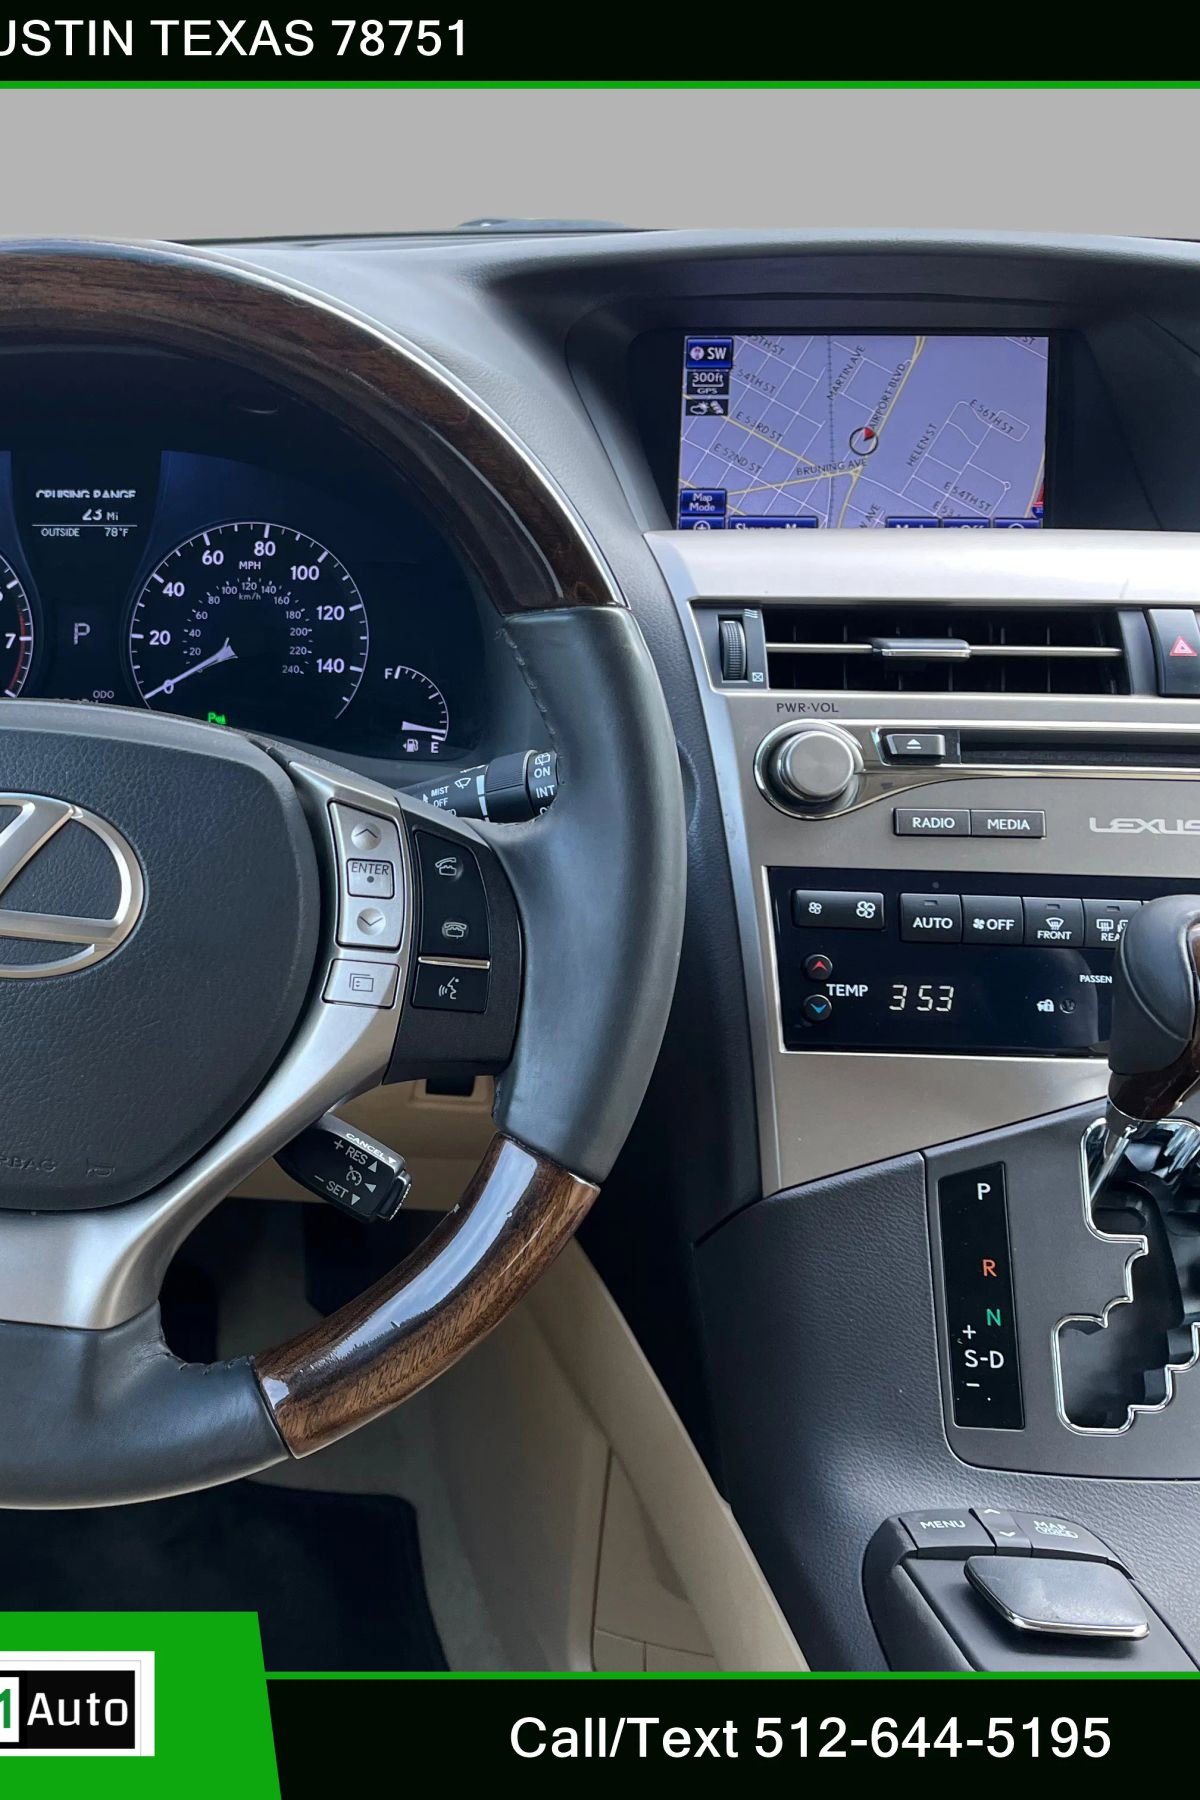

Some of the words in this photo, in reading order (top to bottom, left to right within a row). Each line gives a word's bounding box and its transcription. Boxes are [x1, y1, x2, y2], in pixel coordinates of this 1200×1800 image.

[707, 347, 727, 360] SW
[692, 372, 723, 382] 300ft
[827, 364, 854, 400] MARTIN
[850, 345, 865, 364] AVE
[870, 390, 893, 430] AIRPORT
[888, 363, 906, 389] BLVD
[969, 399, 977, 407] E
[977, 404, 1004, 426] 56TH
[1003, 422, 1014, 433] ST
[735, 411, 743, 420] E
[770, 432, 783, 442] ST
[906, 436, 931, 467] HELEN
[928, 424, 937, 437] ST
[713, 443, 721, 451] E
[749, 463, 762, 474] ST
[796, 461, 844, 477] BRUNING
[848, 458, 867, 469] AVE
[692, 493, 713, 503] Map
[689, 503, 716, 512] Mode
[979, 500, 992, 512] ST
[106, 511, 119, 521] Mi
[41, 528, 80, 537] OUTSIDE
[254, 541, 276, 557] 80
[202, 550, 224, 566] 60
[238, 560, 262, 571] MPH
[290, 565, 320, 581] 100
[163, 582, 185, 597] 40
[221, 586, 238, 595] 100
[241, 582, 257, 591] 120
[261, 586, 277, 594] 140
[208, 596, 220, 605] 80
[238, 592, 261, 601] km/h
[273, 596, 290, 605] 160
[195, 611, 208, 620] 60
[285, 610, 301, 619] 180
[316, 605, 345, 620] 120
[74, 623, 90, 645] P
[149, 630, 171, 645] 20
[188, 629, 201, 637] 40
[289, 627, 308, 636] 200
[5, 634, 16, 648] 7
[189, 647, 201, 656] 20
[289, 646, 307, 655] 220
[282, 665, 300, 674] 240
[316, 658, 345, 674] 140
[385, 668, 393, 679] F
[92, 690, 115, 699] ODO
[431, 741, 439, 753] E
[534, 766, 550, 778] ON
[431, 785, 449, 797] MIST
[535, 785, 555, 799] INT
[912, 816, 955, 829] RADIO
[987, 818, 1030, 831] MEDIA
[351, 862, 389, 876] ENTER
[913, 917, 953, 930] AUTO
[986, 918, 1015, 931] OFF
[1037, 930, 1072, 941] FRONT
[1101, 932, 1120, 942] REA
[1079, 974, 1113, 984] PASSEN
[826, 983, 869, 997] TEMP
[345, 1132, 386, 1160] CANCEL
[977, 1182, 991, 1201] P
[983, 1259, 997, 1277] R
[986, 1308, 1001, 1327] N
[920, 1519, 966, 1530] MENU
